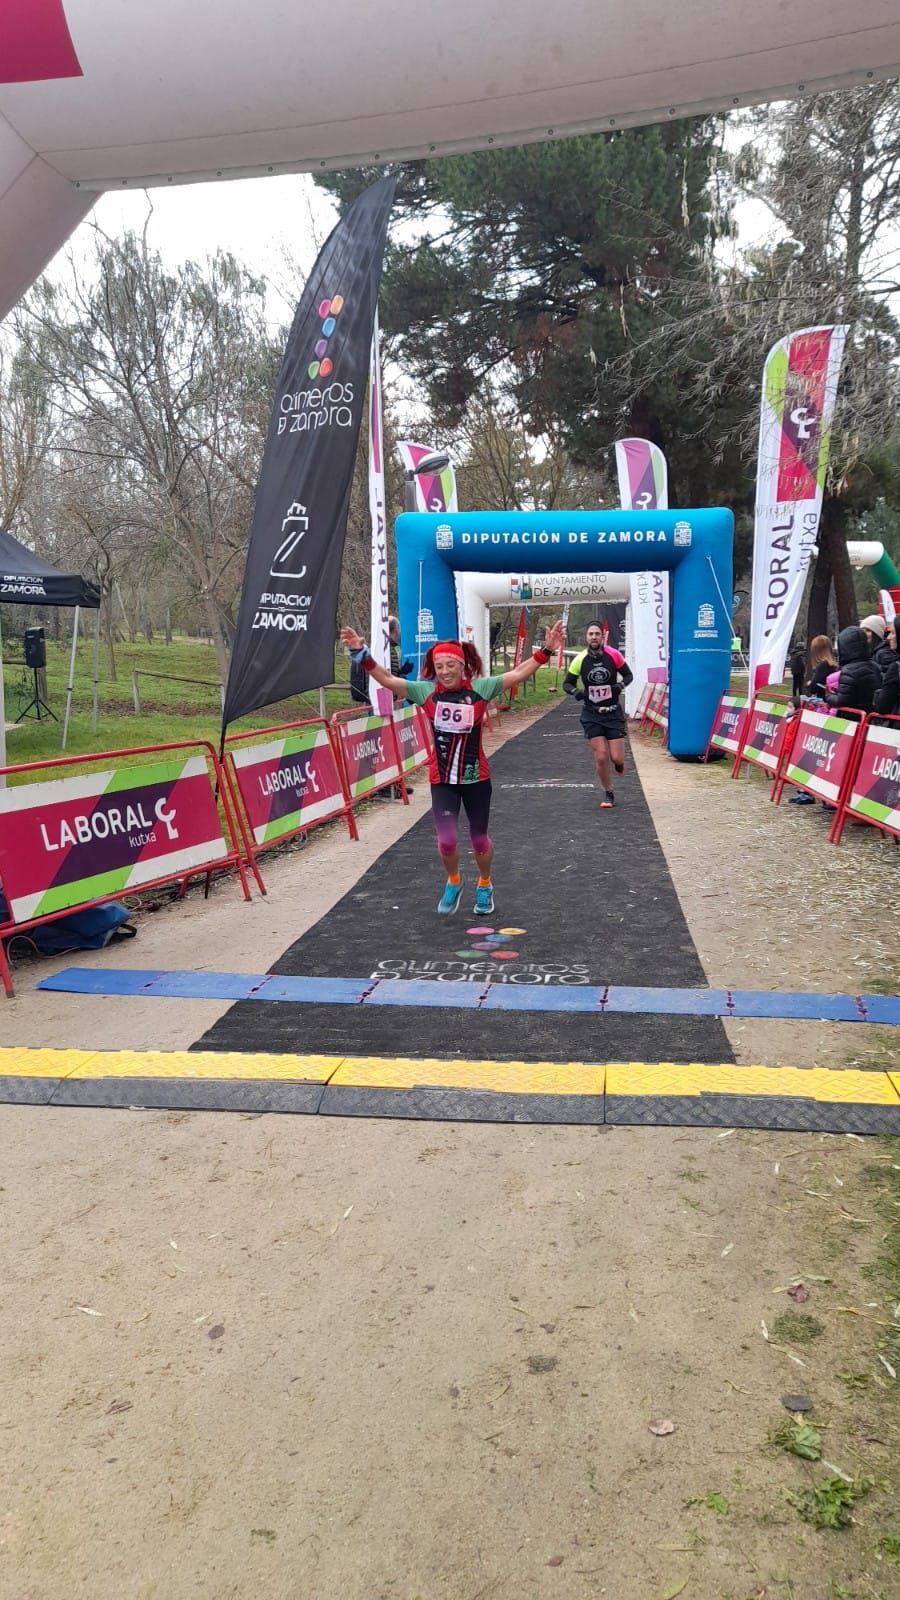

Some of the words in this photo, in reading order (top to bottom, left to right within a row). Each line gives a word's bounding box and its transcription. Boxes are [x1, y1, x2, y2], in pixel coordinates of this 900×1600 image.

[461, 529, 560, 544] DIPUTACIÓN
[568, 532, 588, 543] DE
[597, 530, 667, 543] ZAMORA
[534, 574, 607, 586] AYUNTAMIENTO
[764, 515, 795, 638] BORAL
[0, 583, 47, 596] ZAMORA
[535, 586, 549, 597] DE
[554, 584, 607, 596] ZAMORA
[590, 688, 608, 698] 117
[441, 707, 462, 722] 96
[258, 764, 306, 796] LABORAL
[41, 802, 153, 852] LABORAL
[129, 832, 157, 849] kutxa
